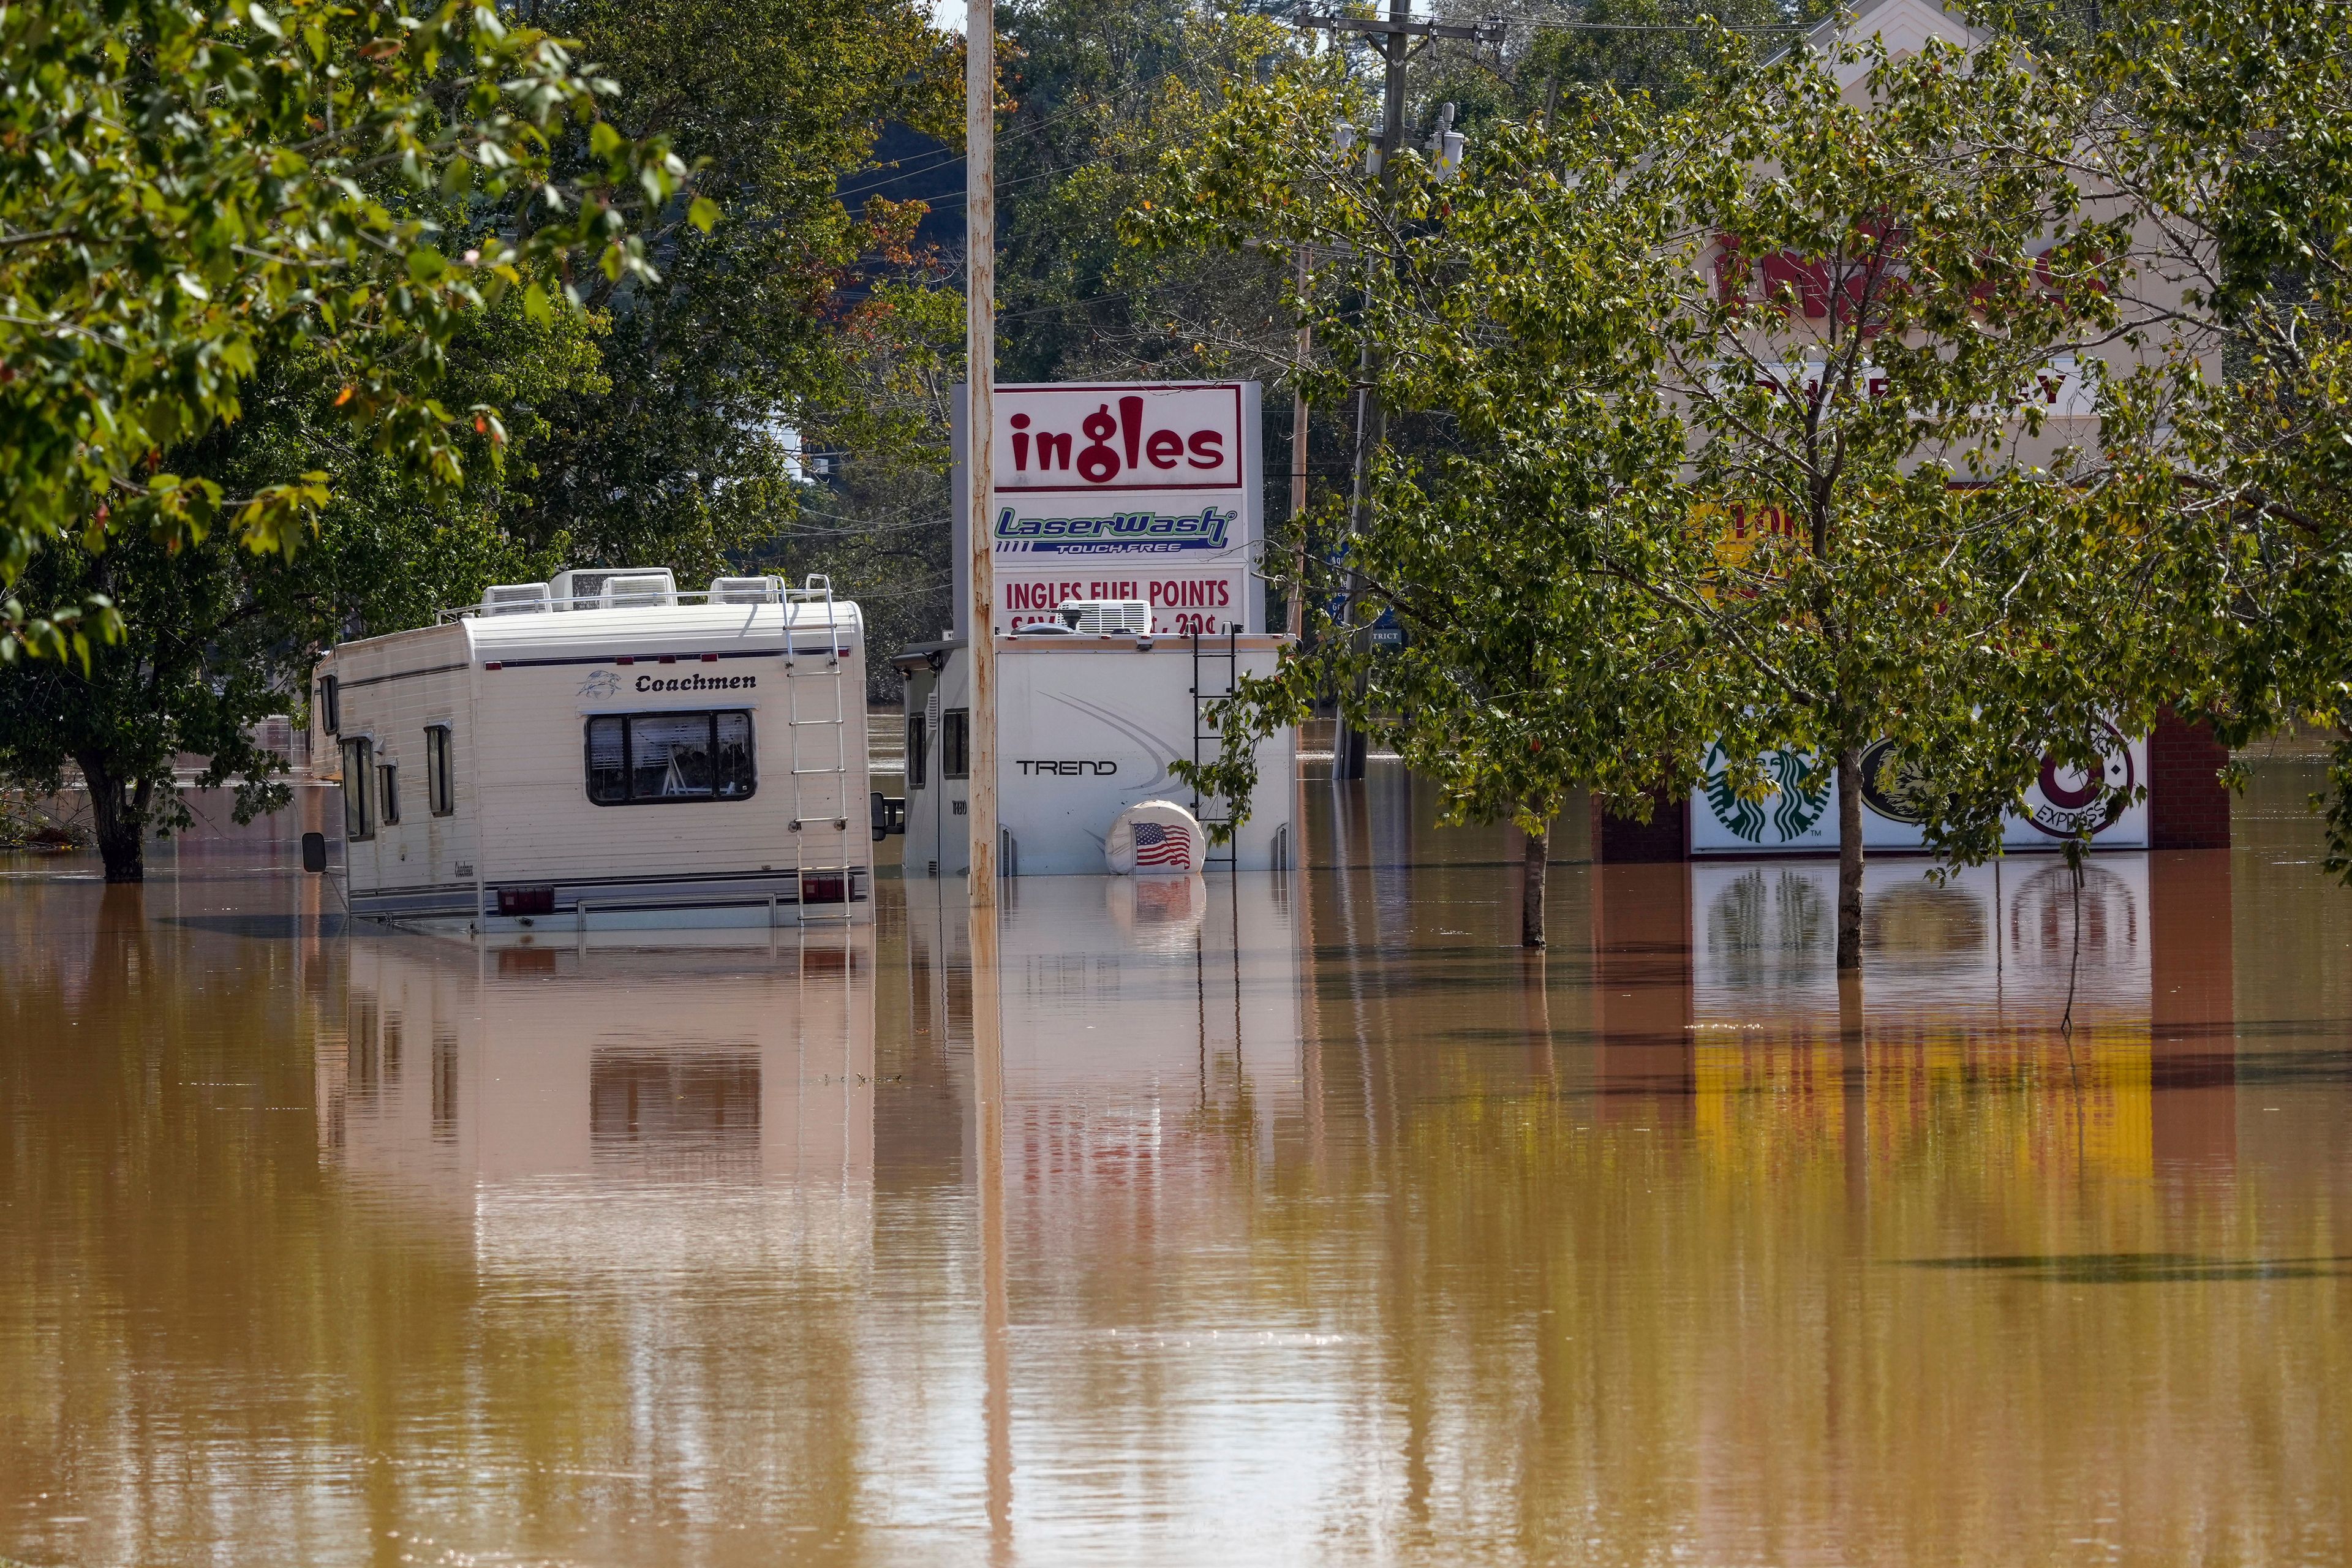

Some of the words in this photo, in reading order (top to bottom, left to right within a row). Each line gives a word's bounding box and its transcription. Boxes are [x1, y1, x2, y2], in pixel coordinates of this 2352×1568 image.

[1714, 203, 2108, 339] inges
[1010, 396, 1224, 483] ingles
[1006, 582, 1082, 609] INGLES
[1150, 580, 1229, 607] POINTS
[635, 673, 756, 692] Coachmen
[1016, 760, 1117, 775] TREND
[2036, 802, 2106, 831] EXPRESS
